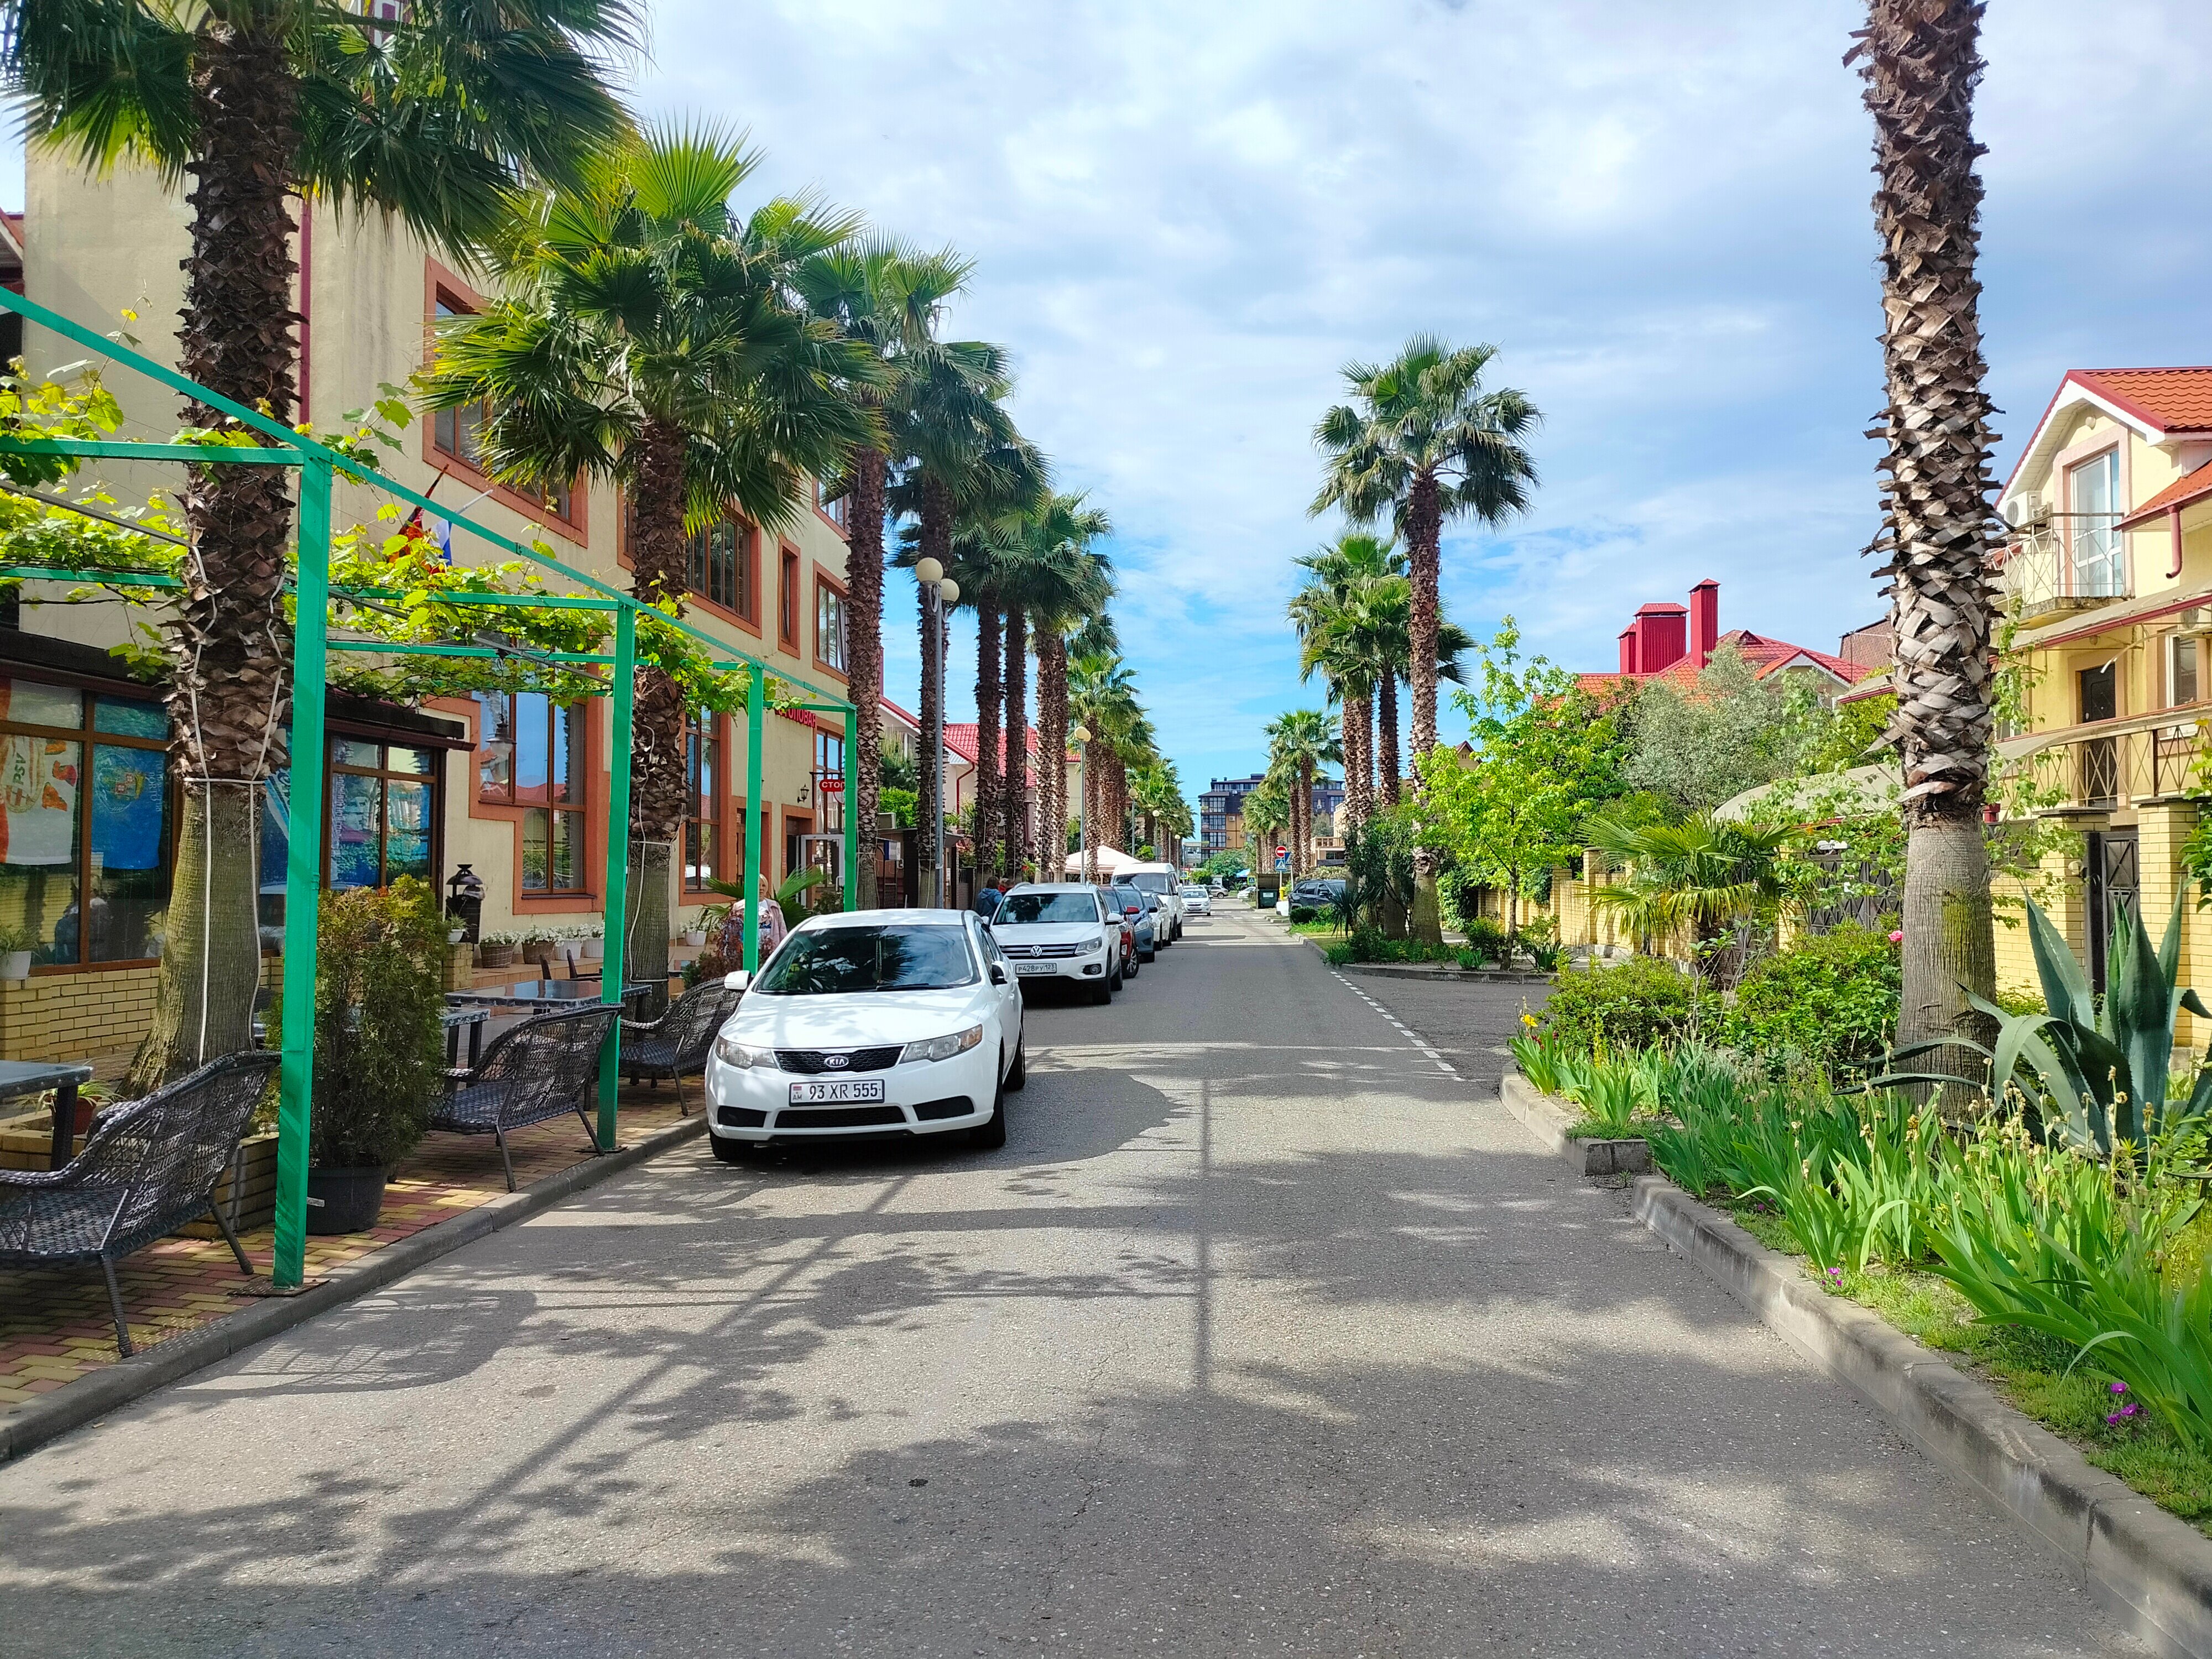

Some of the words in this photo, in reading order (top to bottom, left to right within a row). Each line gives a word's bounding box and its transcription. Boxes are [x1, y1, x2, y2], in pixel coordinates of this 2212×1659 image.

[779, 708, 816, 727] ОЛОВАЯ
[809, 1085, 825, 1100] 93
[830, 1084, 849, 1099] XR
[853, 1083, 878, 1098] 555
